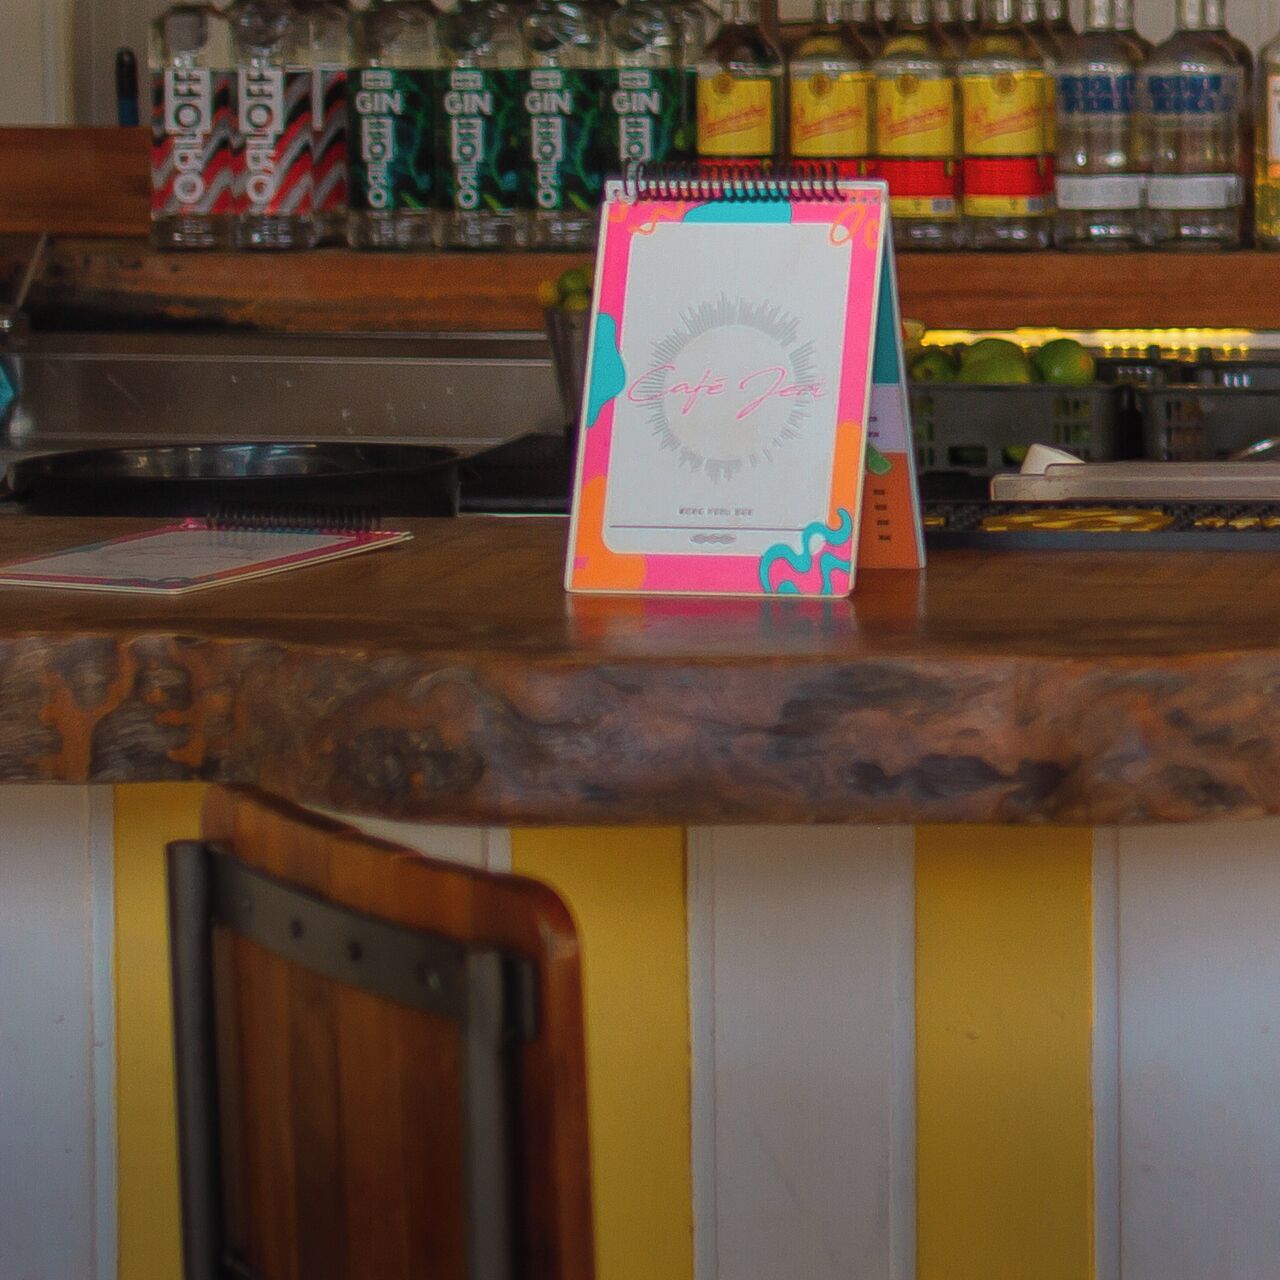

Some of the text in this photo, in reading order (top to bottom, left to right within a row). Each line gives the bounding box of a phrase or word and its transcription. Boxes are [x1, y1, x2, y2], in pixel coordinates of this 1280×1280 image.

[355, 90, 402, 116] GIN
[444, 90, 493, 116] GIN
[524, 90, 573, 116] GIN
[612, 90, 661, 116] GIN
[626, 364, 729, 416] Café
